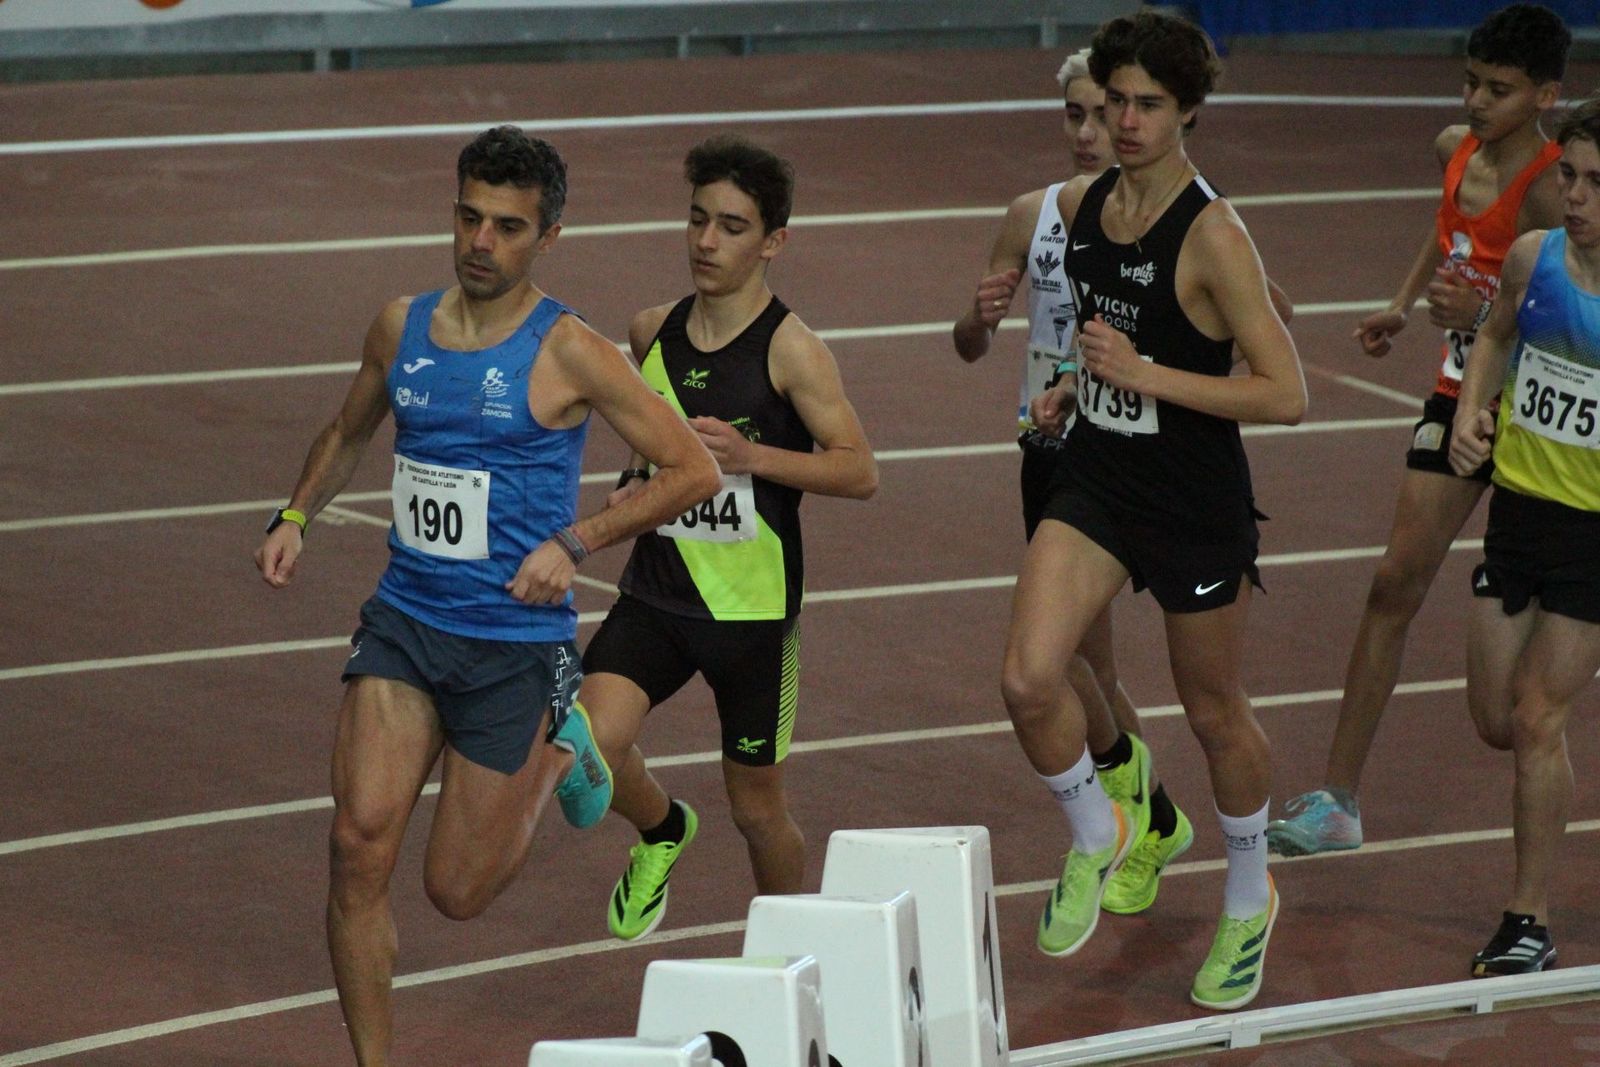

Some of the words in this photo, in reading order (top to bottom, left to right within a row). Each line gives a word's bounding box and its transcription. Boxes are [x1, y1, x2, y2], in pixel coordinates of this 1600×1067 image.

[1040, 235, 1066, 244] VIATOR
[1094, 294, 1140, 320] VICKY
[1103, 315, 1138, 333] OODS
[682, 378, 706, 390] ZICO
[1081, 366, 1143, 422] 3739
[481, 408, 513, 419] ZAMORA
[1520, 377, 1598, 437] 3675
[418, 477, 439, 487] CASTILLA
[438, 471, 464, 480] ATLETISMO
[409, 493, 463, 546] 190
